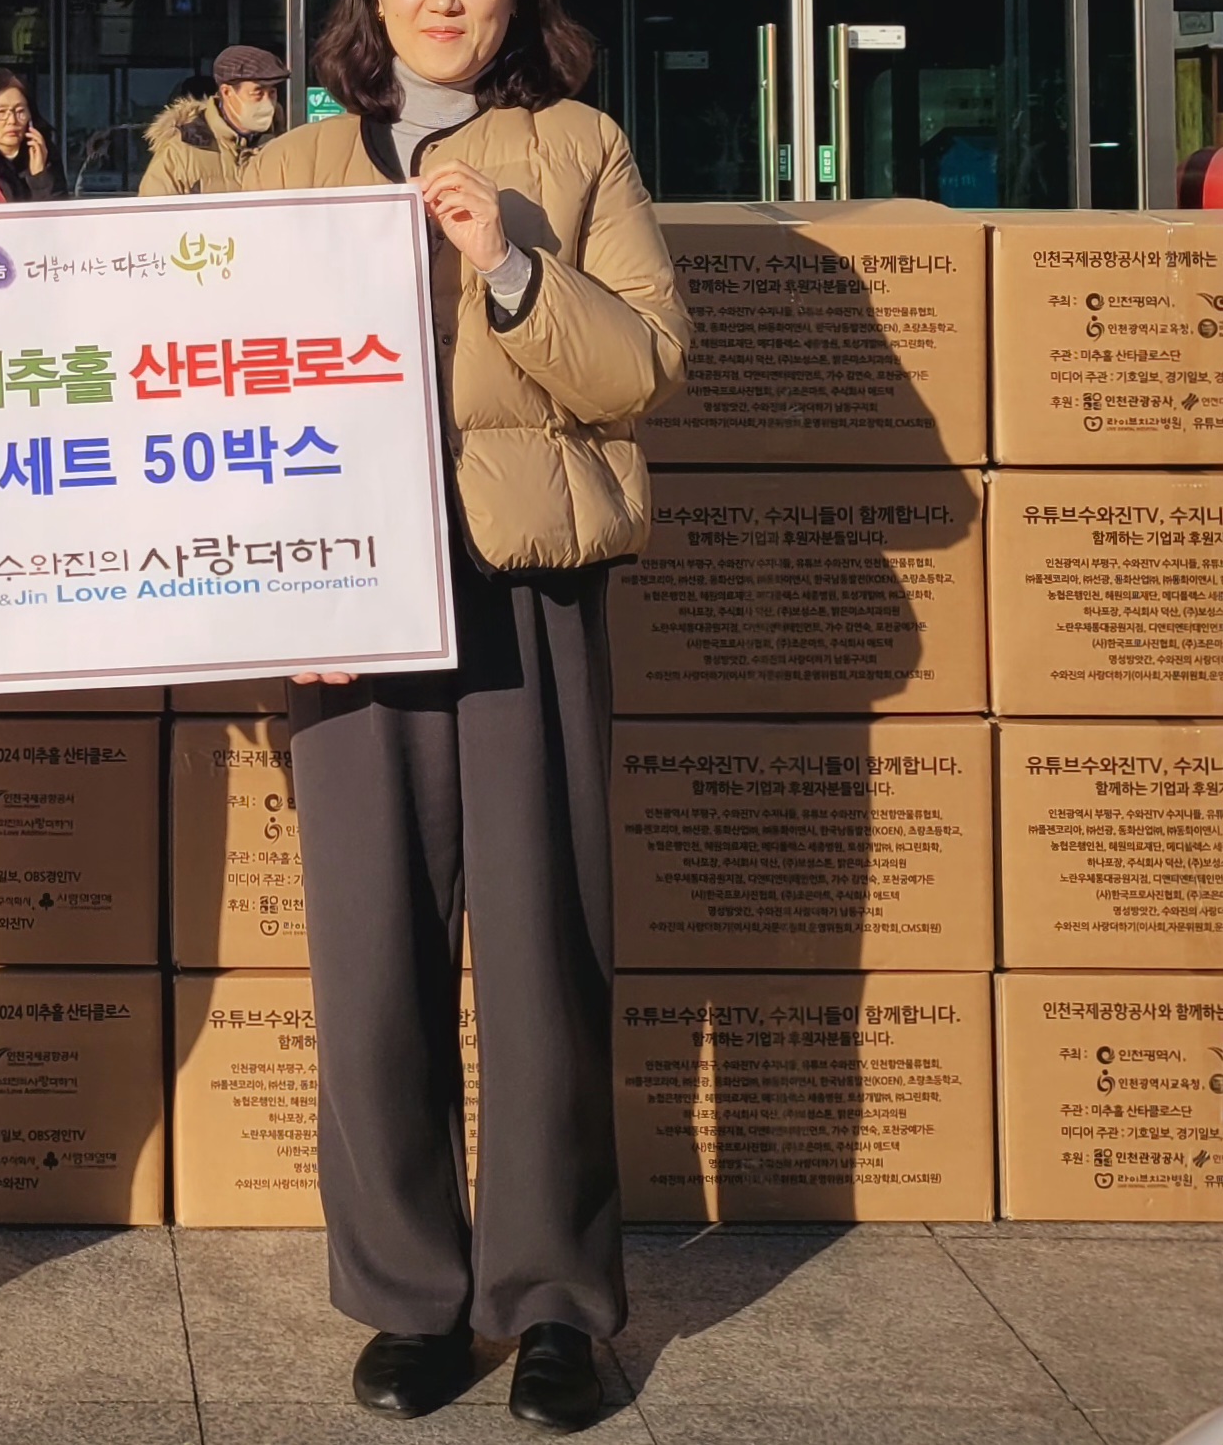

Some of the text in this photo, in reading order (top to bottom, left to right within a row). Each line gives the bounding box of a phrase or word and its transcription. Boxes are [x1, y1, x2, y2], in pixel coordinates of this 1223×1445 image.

[24, 252, 74, 283] 더불어
[81, 257, 107, 276] 사는
[112, 251, 167, 278] 따뜻한
[171, 232, 234, 286] 부평
[861, 255, 956, 274] 함께합니다.
[1033, 251, 1217, 268] 인천국제공항공사와 함께하는
[688, 279, 740, 294] 함께하는
[743, 279, 784, 294] 기업과
[129, 334, 404, 400] 산타클로스
[143, 426, 342, 484] 50박스
[859, 505, 953, 525] 함께합니다.
[1023, 506, 1164, 525] 유튜브수와진TV,
[687, 531, 739, 546] 함께하는
[140, 535, 377, 576] 사랑더하기
[57, 581, 127, 603] Love
[137, 575, 261, 599] Addition
[267, 574, 379, 593] Corporation
[23, 747, 61, 765] 미추홀
[61, 747, 127, 765] 산타클로스
[770, 756, 860, 776] 수지니들이
[865, 756, 962, 775] 함께합니다.
[1025, 757, 1168, 775] 유튜브수와진TV,
[692, 780, 745, 796] 함께하는
[745, 780, 786, 796] 기업과
[26, 1003, 64, 1022] 미추홀
[64, 1004, 131, 1021] 산타클로스
[865, 1005, 960, 1025] 함께합니다.
[1043, 1002, 1172, 1020] 인천국제공항공사와
